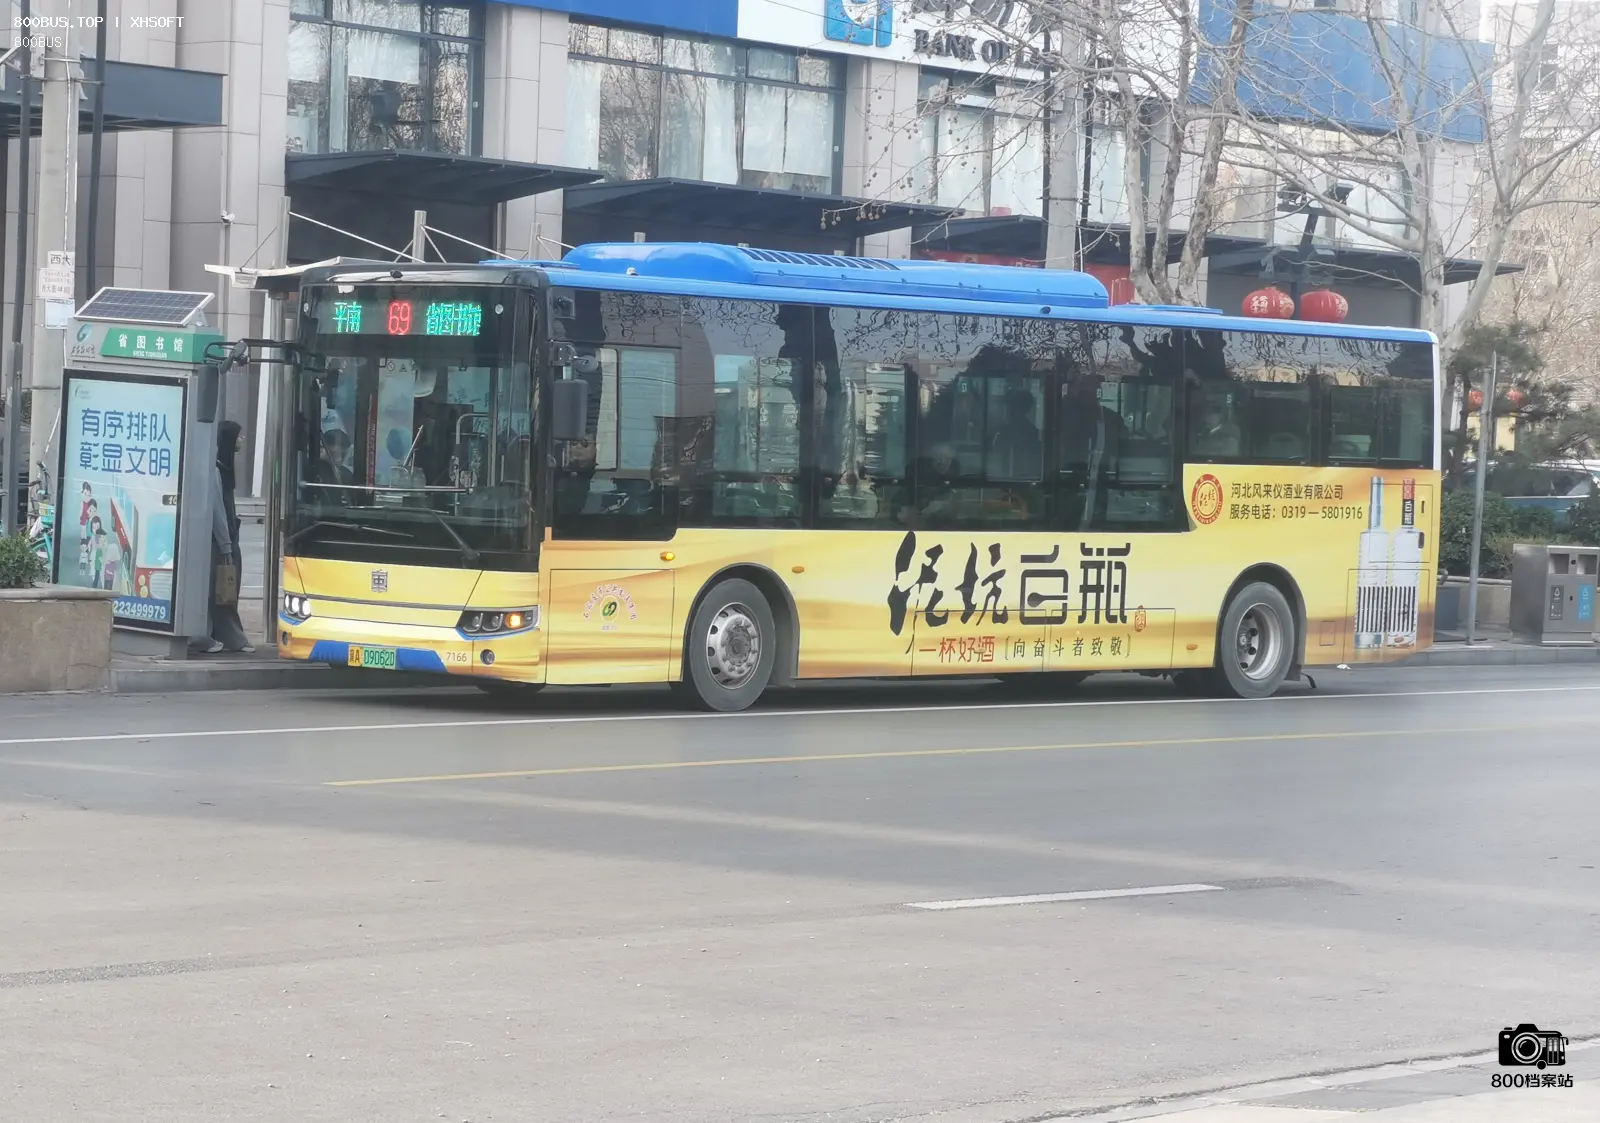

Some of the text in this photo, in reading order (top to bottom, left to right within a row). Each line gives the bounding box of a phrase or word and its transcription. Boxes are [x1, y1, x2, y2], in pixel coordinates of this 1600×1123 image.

[913, 28, 977, 61] BANK
[388, 302, 411, 334] 69
[426, 302, 482, 336] 省图书馆
[118, 333, 184, 353] 省图书馆
[81, 408, 171, 443] 有序排队
[79, 441, 171, 478] 彰显文明
[446, 651, 468, 662] 7166
[919, 636, 996, 663] 一杯好酒
